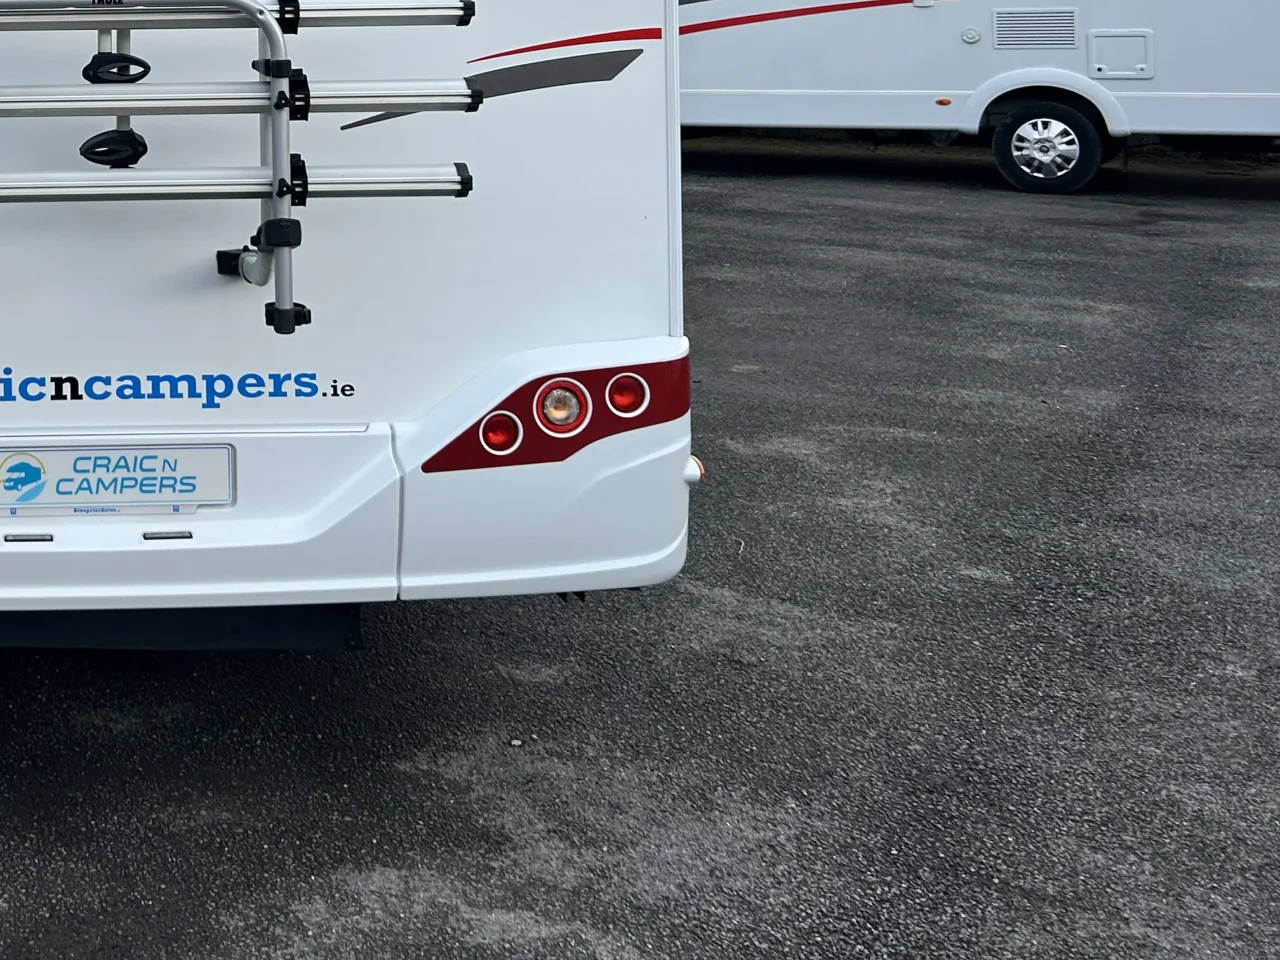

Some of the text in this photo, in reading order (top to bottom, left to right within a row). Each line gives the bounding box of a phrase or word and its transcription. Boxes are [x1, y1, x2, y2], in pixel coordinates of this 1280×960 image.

[73, 455, 177, 473] CRAIC N
[55, 476, 197, 495] CAMPERS
